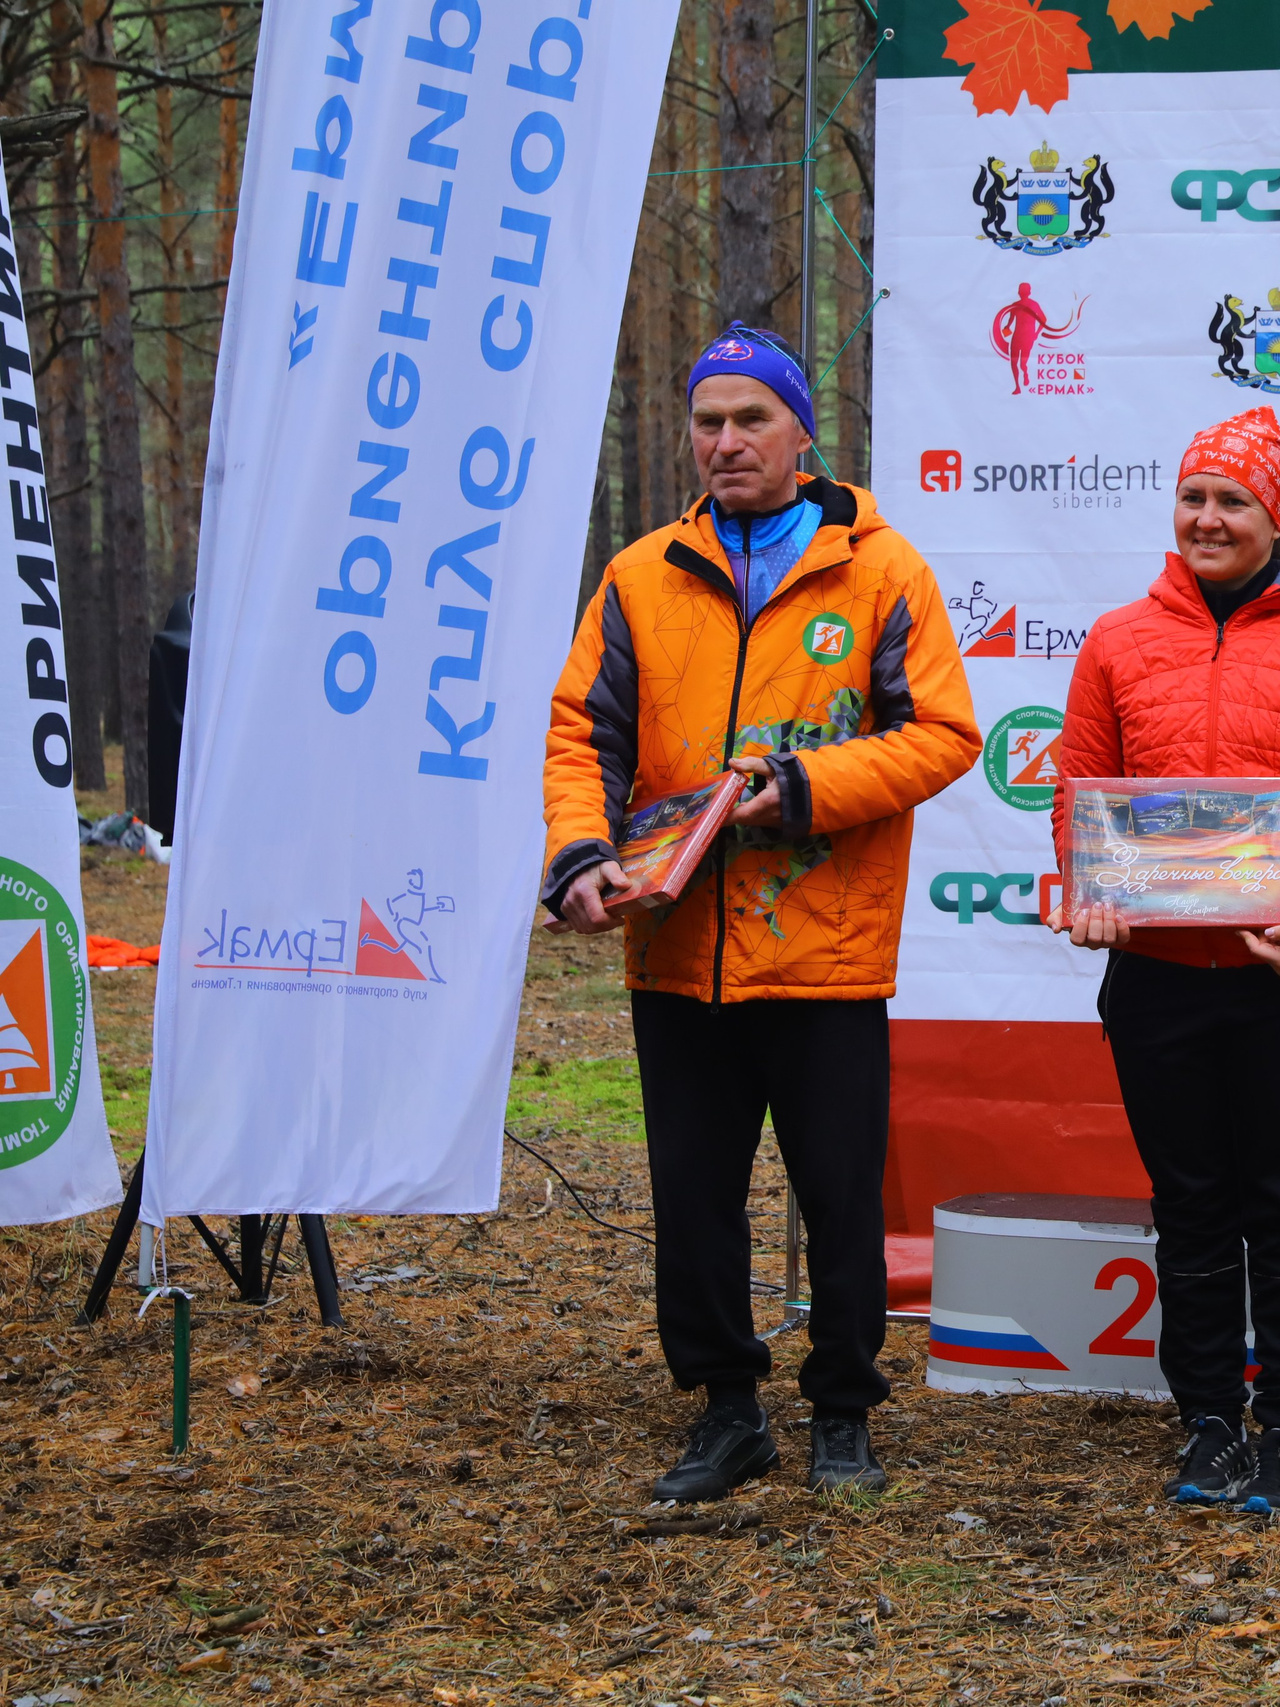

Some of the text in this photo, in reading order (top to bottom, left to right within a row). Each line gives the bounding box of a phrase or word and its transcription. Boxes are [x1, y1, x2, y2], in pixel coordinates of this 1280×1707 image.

[1038, 353, 1085, 365] КУБОК
[1037, 368, 1068, 380] КСО
[1028, 382, 1095, 396] «ЕРМАК»
[1203, 450, 1245, 469] BAIKAL
[0, 195, 75, 788] ОРИЕНТИ
[1052, 492, 1122, 509] siberia
[1026, 621, 1086, 660] Ерм
[1016, 711, 1064, 726] СПОРТИВНОГ
[1011, 795, 1054, 806] ЮМЕНСКОЙ
[1096, 842, 1215, 894] Заречные
[54, 920, 85, 1113] ОРИЕНТИРОВАНИЯ
[1089, 1257, 1158, 1358] 2
